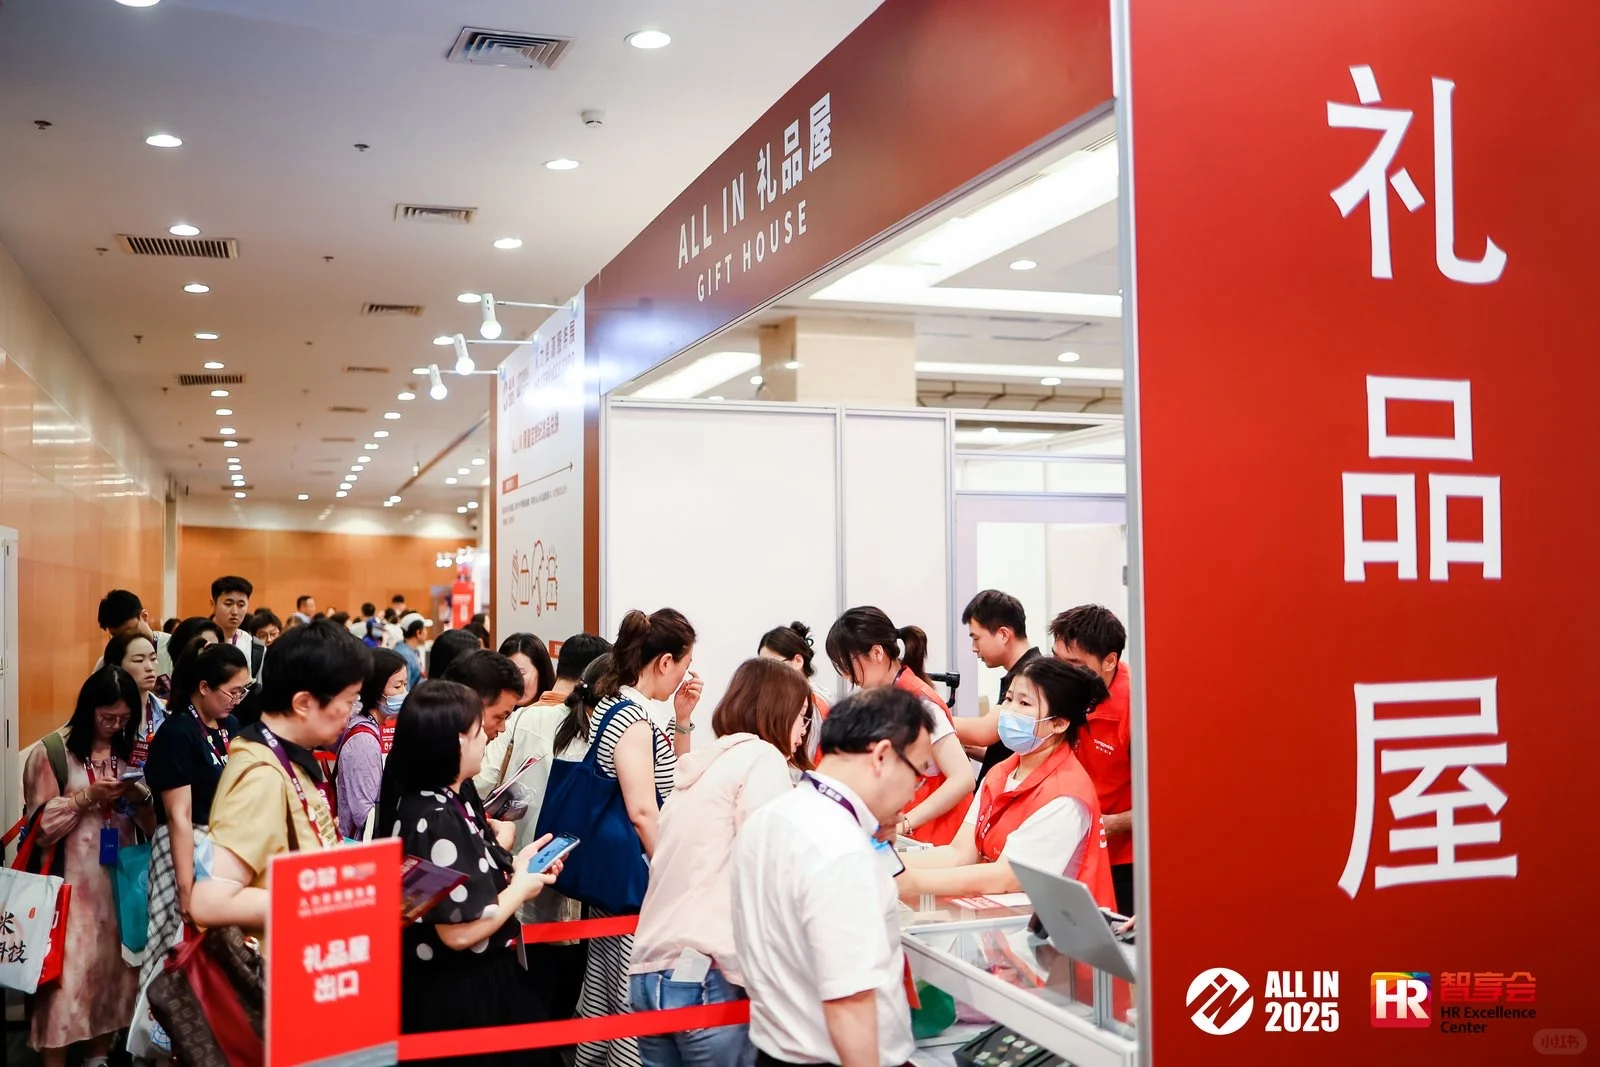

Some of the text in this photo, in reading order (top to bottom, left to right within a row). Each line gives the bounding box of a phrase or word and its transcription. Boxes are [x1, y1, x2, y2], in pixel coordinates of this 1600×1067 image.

[678, 92, 832, 269] ALL IN 礼品屋
[697, 199, 807, 303] GIFT HOUSE
[1327, 64, 1517, 898] 礼品屋
[303, 935, 370, 973] 礼品屋
[312, 970, 359, 1003] 出口
